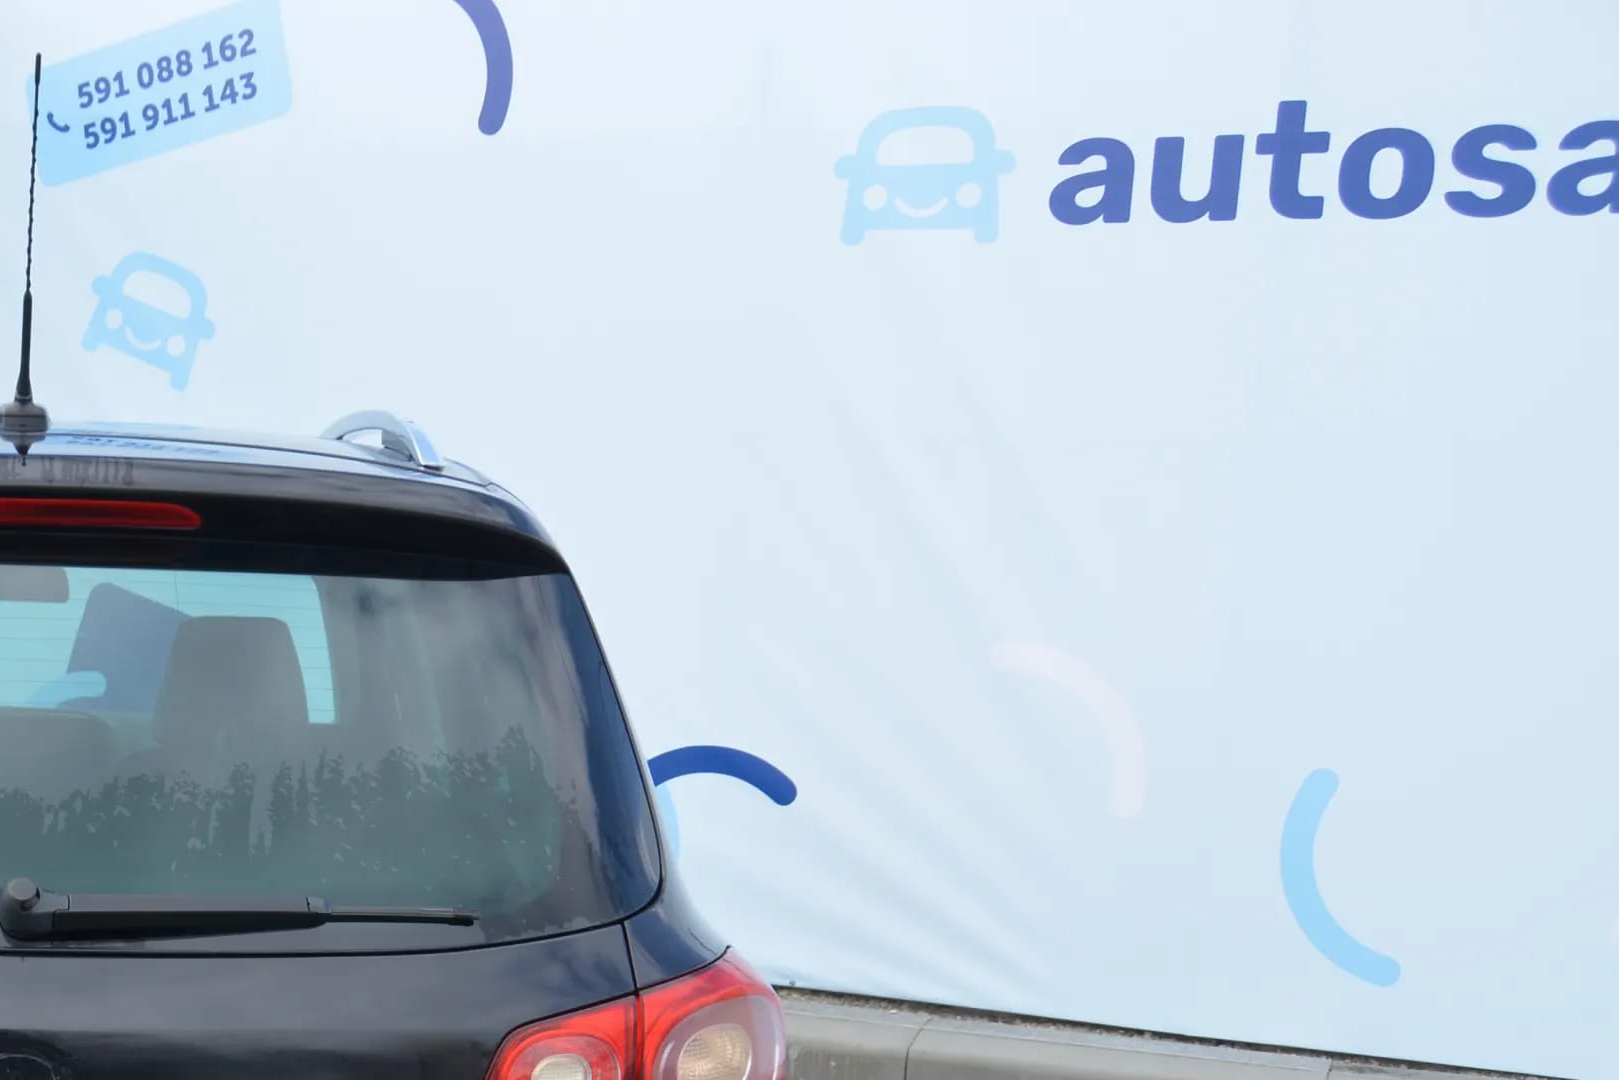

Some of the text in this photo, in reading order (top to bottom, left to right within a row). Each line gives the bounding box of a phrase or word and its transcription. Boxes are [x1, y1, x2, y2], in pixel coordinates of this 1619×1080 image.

[77, 28, 257, 110] 591 088 162
[82, 71, 258, 151] 591 911 143
